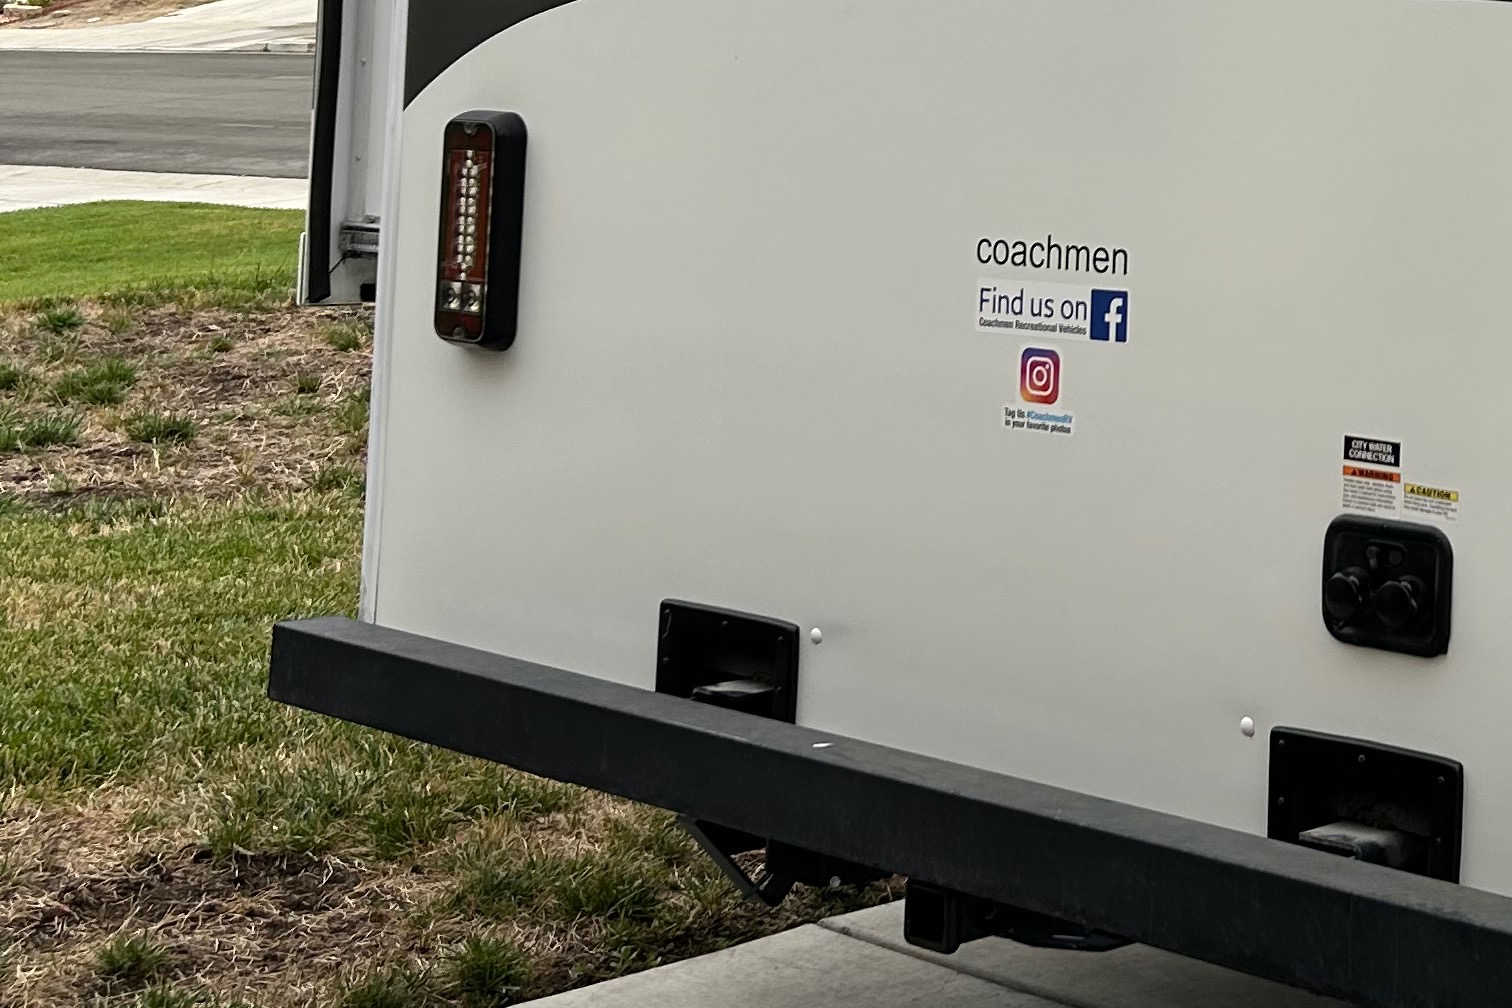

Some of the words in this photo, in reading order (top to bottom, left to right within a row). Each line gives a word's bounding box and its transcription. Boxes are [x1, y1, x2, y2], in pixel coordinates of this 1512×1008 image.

[977, 234, 1128, 276] coachmen
[979, 287, 1025, 316] Find
[1030, 297, 1055, 318] us
[1060, 299, 1088, 321] on
[1351, 439, 1368, 451] CITY
[1368, 441, 1393, 454] WATER
[1348, 448, 1395, 464] CONNECTION
[1416, 486, 1452, 500] CAUTION
